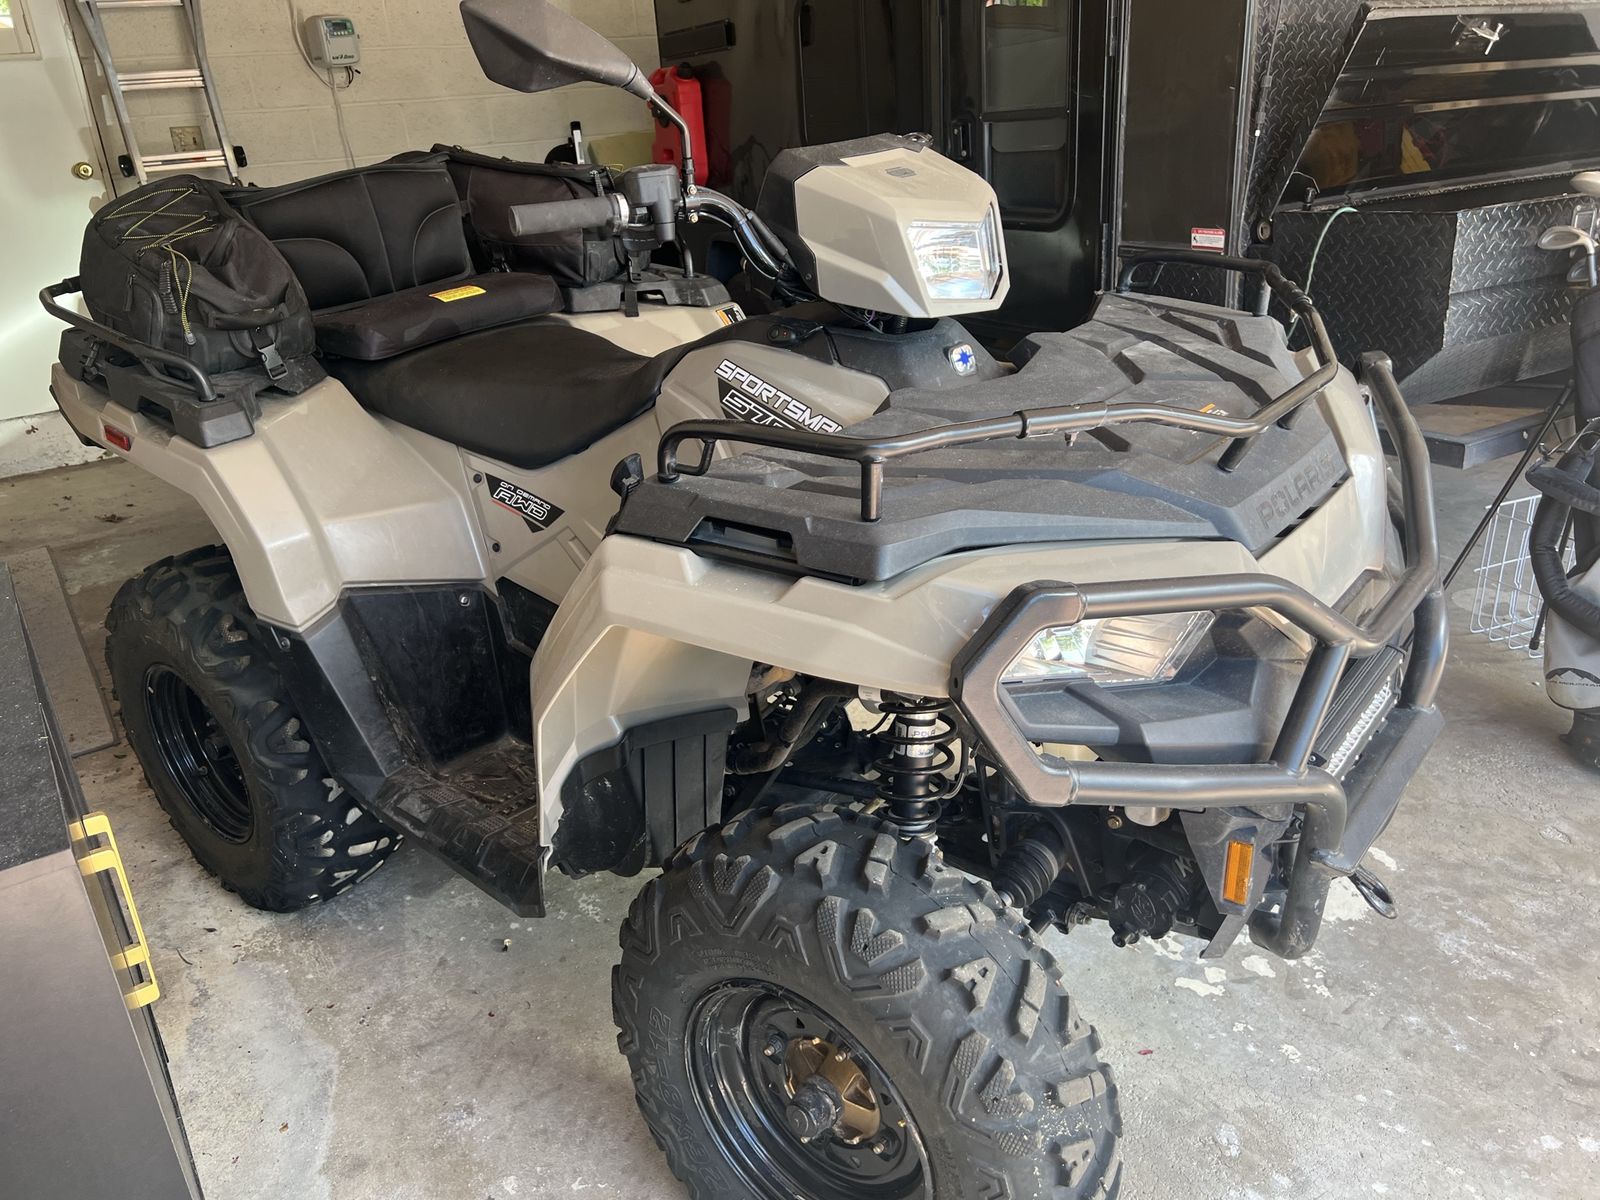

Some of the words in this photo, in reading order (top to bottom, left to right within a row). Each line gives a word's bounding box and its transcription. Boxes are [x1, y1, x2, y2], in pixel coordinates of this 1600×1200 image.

[714, 358, 843, 433] SPORTSMA
[493, 486, 548, 521] AWD
[1255, 451, 1337, 530] POLARIS
